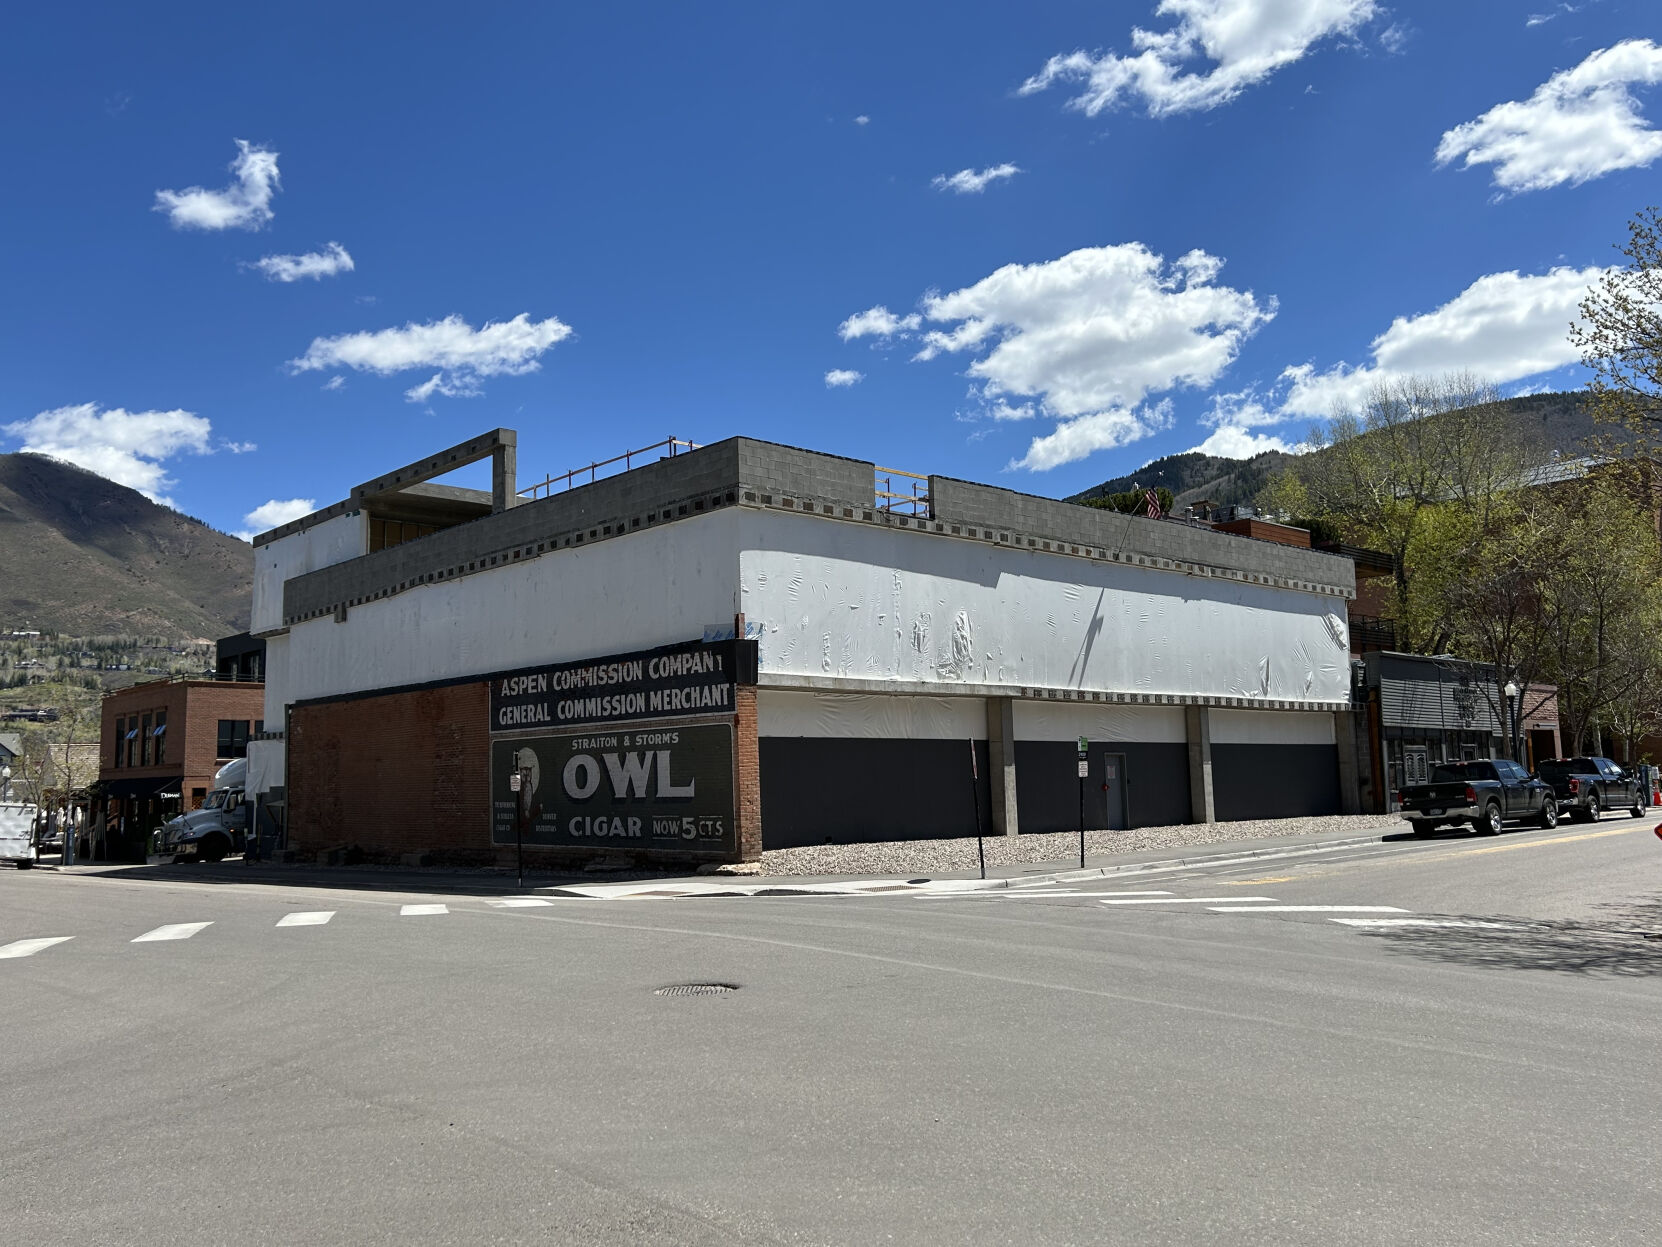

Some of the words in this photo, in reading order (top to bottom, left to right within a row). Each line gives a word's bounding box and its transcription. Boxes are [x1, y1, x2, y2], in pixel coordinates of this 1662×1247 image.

[501, 672, 547, 697] ASPEN
[552, 660, 643, 691] COMMISSION
[499, 702, 551, 725] GENERAL
[557, 692, 645, 720] COMMISSION
[649, 683, 730, 711] MERCHANT
[572, 736, 617, 750] STRAITON
[623, 735, 631, 746] &
[635, 732, 679, 746] STORM'S
[563, 750, 695, 799] OWL
[569, 816, 642, 838] CIGAR
[653, 819, 680, 835] NOW
[681, 817, 697, 840] 5
[698, 820, 724, 836] CTS
